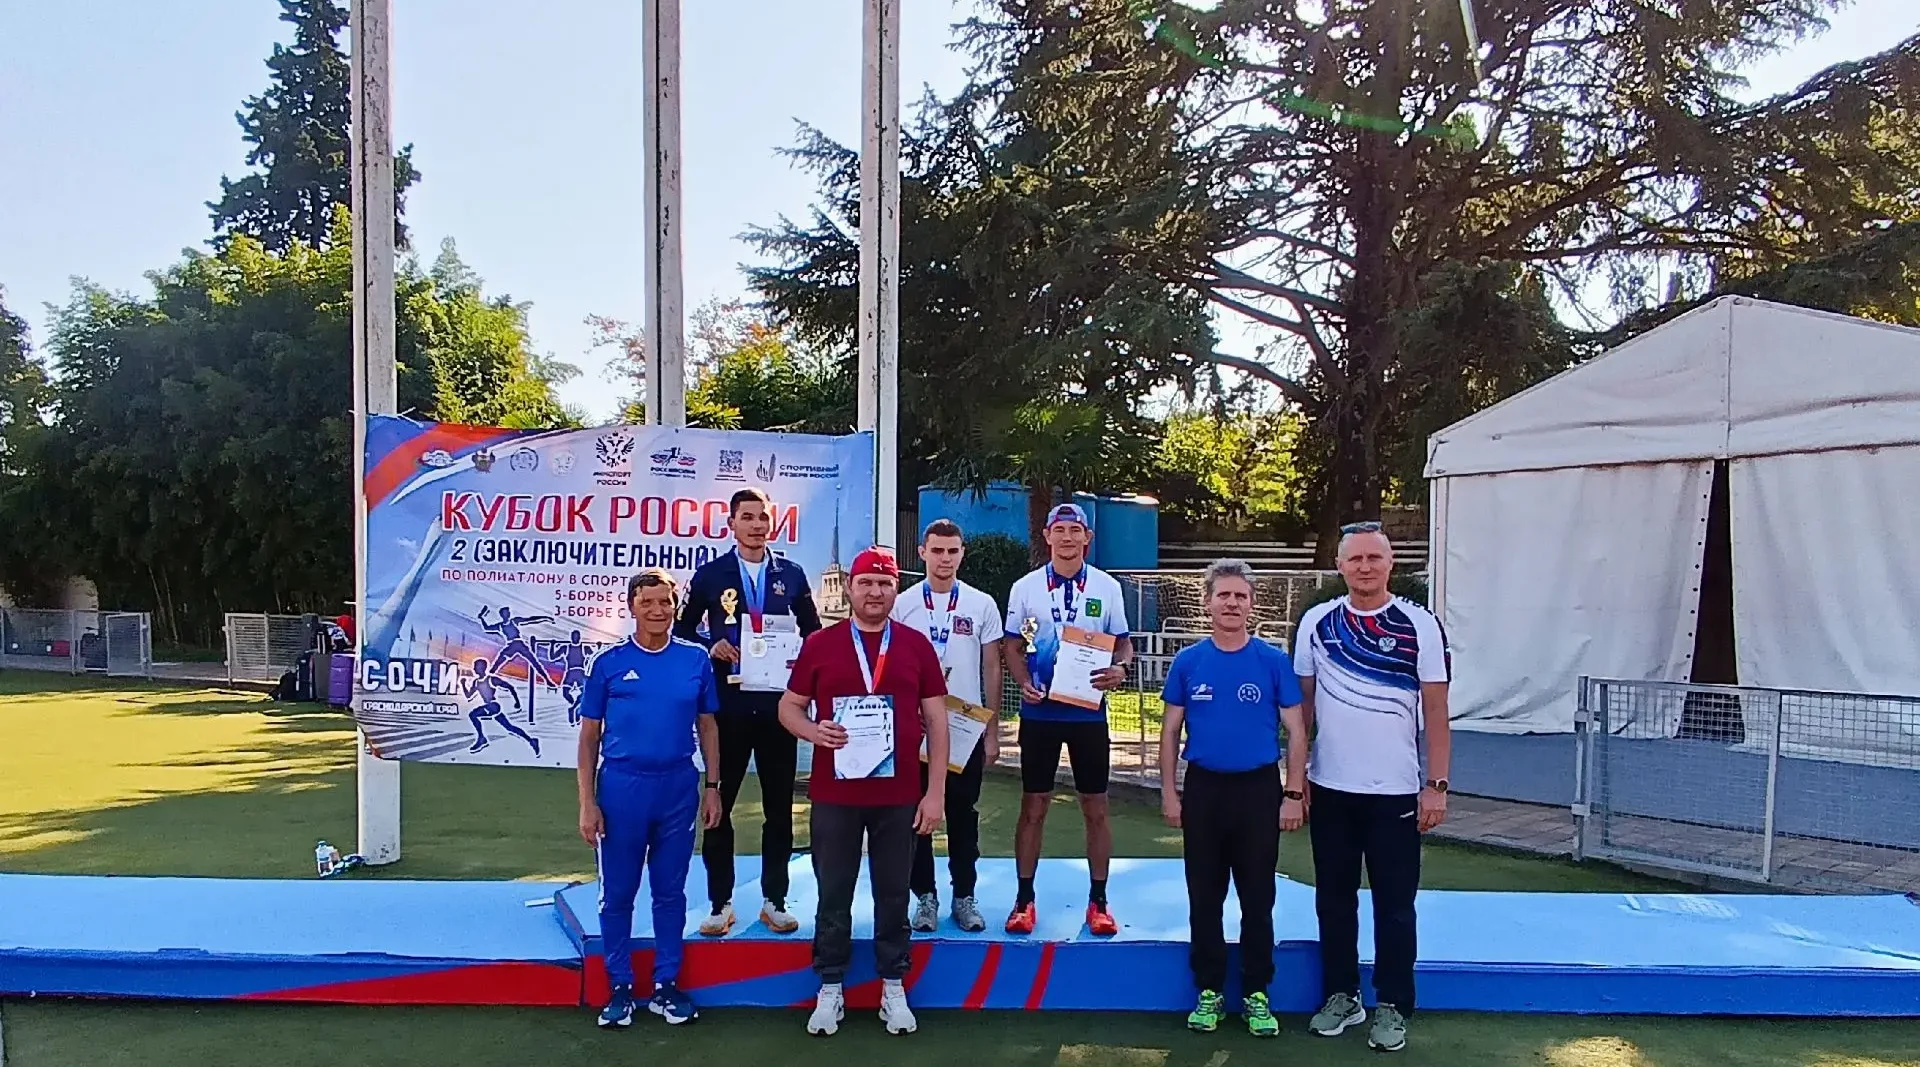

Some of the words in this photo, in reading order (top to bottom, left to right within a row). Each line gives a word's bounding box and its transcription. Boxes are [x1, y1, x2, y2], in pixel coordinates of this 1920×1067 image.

[443, 492, 594, 532] КУБОК
[610, 496, 799, 543] РОССИ
[450, 539, 467, 561] 2
[442, 569, 462, 580] ПО
[467, 570, 565, 585] ПОЛИАТЛОНУ
[570, 574, 577, 584] В
[555, 589, 613, 602] 5-БОРЬЕ
[554, 605, 613, 618] 3-БОРЬЕ
[362, 659, 458, 695] СОЧИ
[436, 703, 458, 714] КРАЙ
